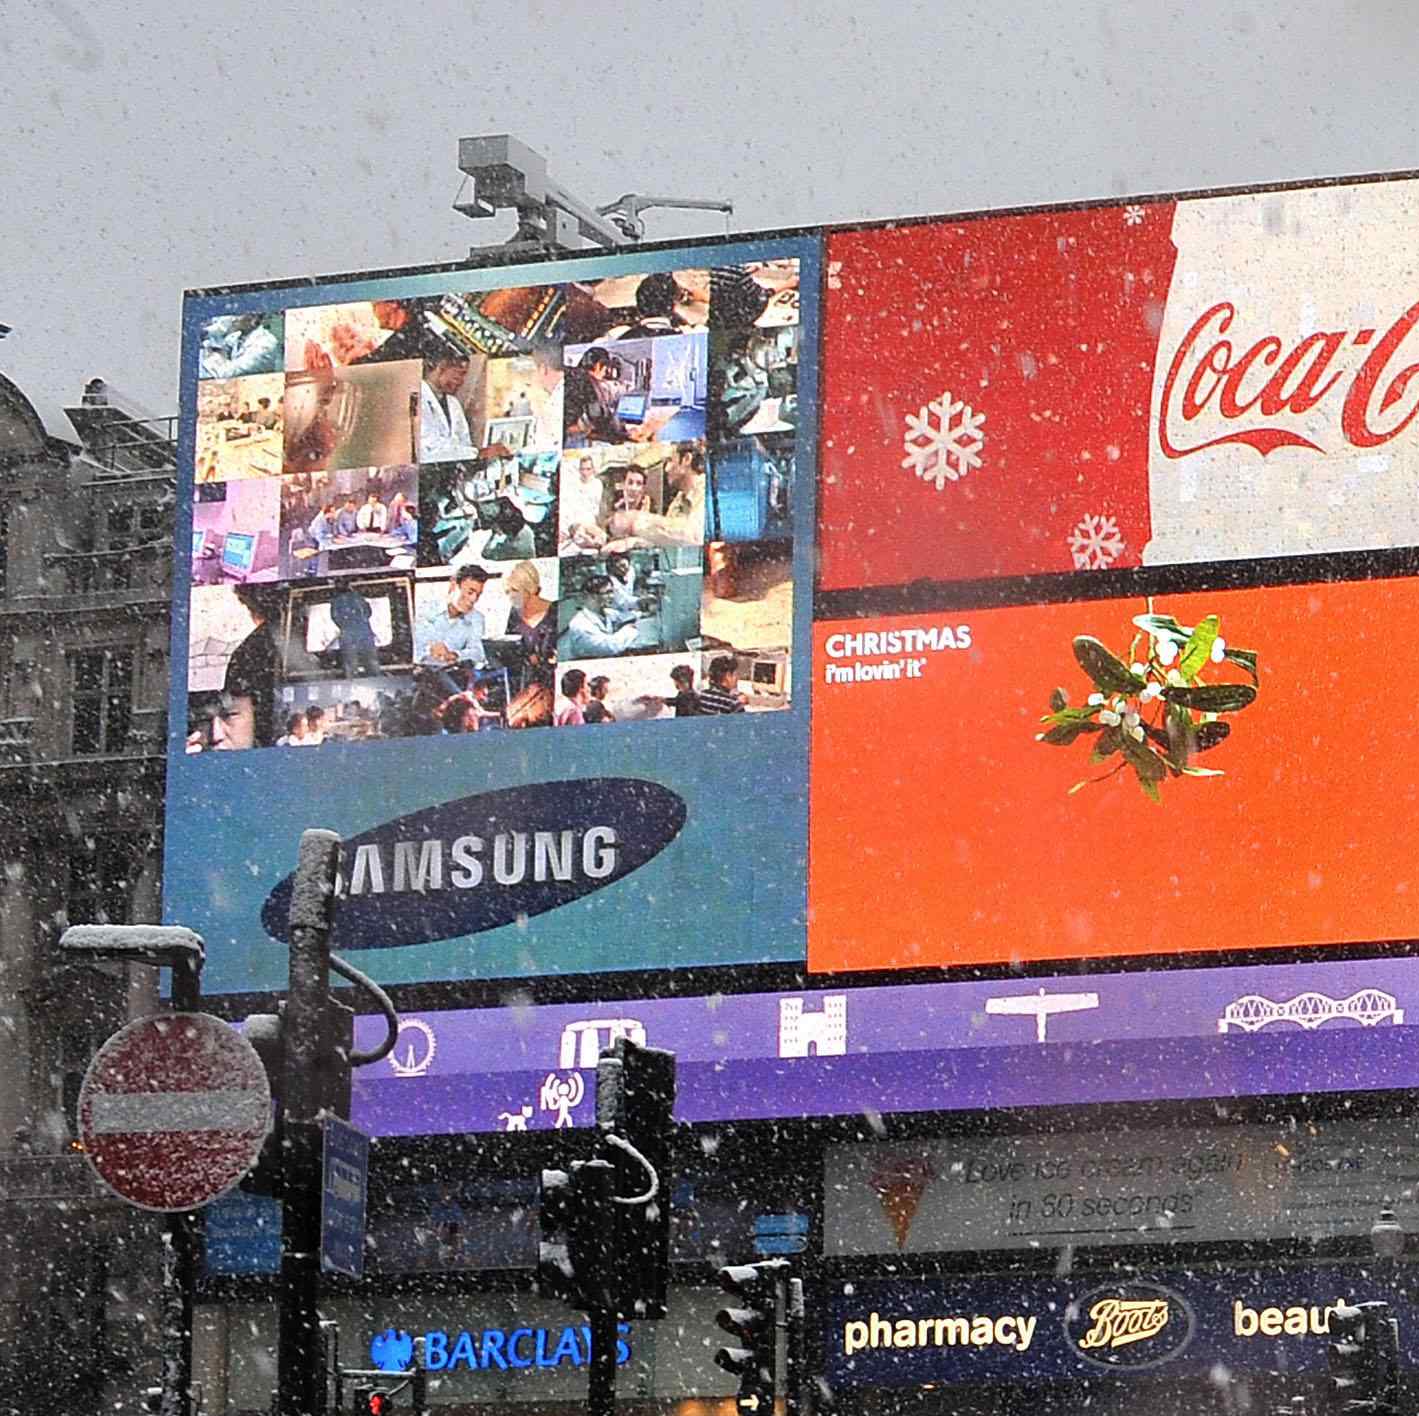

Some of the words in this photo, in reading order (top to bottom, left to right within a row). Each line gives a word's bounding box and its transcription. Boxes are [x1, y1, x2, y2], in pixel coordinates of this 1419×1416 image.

[825, 625, 972, 658] CHRISTMAS
[825, 662, 854, 683] i'm
[855, 659, 904, 682] lovin'
[334, 826, 617, 896] AMSUNG
[965, 1160, 1026, 1184] Love
[1009, 1194, 1031, 1220] in
[844, 1310, 1037, 1355] pharmacy
[1079, 1299, 1170, 1351] Boots
